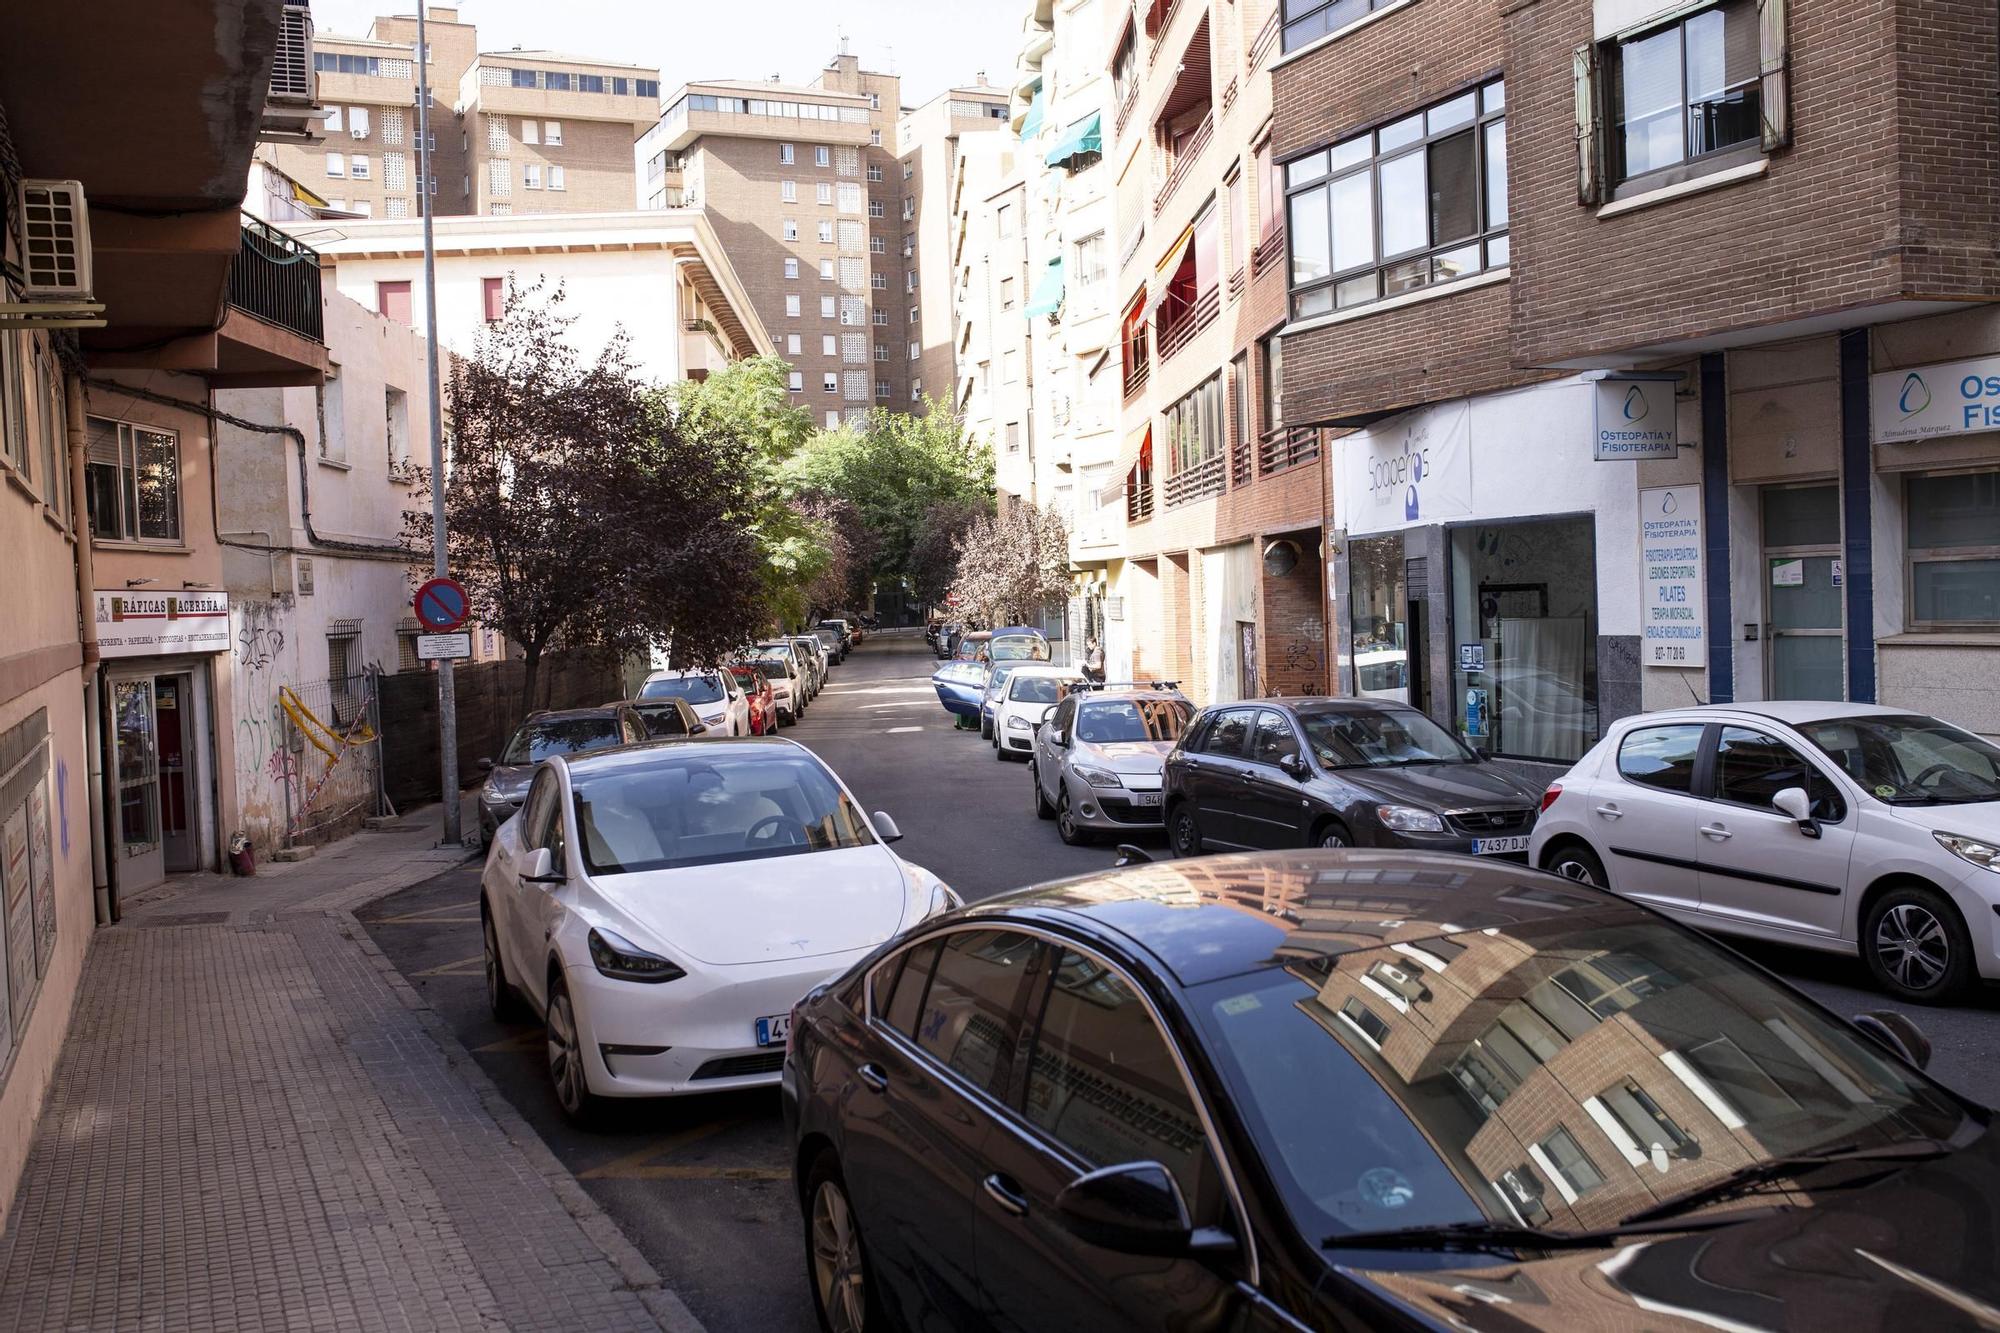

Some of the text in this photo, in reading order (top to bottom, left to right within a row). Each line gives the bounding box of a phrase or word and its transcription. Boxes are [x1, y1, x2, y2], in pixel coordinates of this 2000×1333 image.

[1602, 442, 1671, 453] FISIOTERAPIA
[1644, 529, 1697, 539] FISIOTERAPIA
[1659, 585, 1686, 602] PILATES
[112, 596, 166, 613] GRÁFICAS
[168, 597, 218, 612] CACEREÑA
[1480, 839, 1508, 852] 7437
